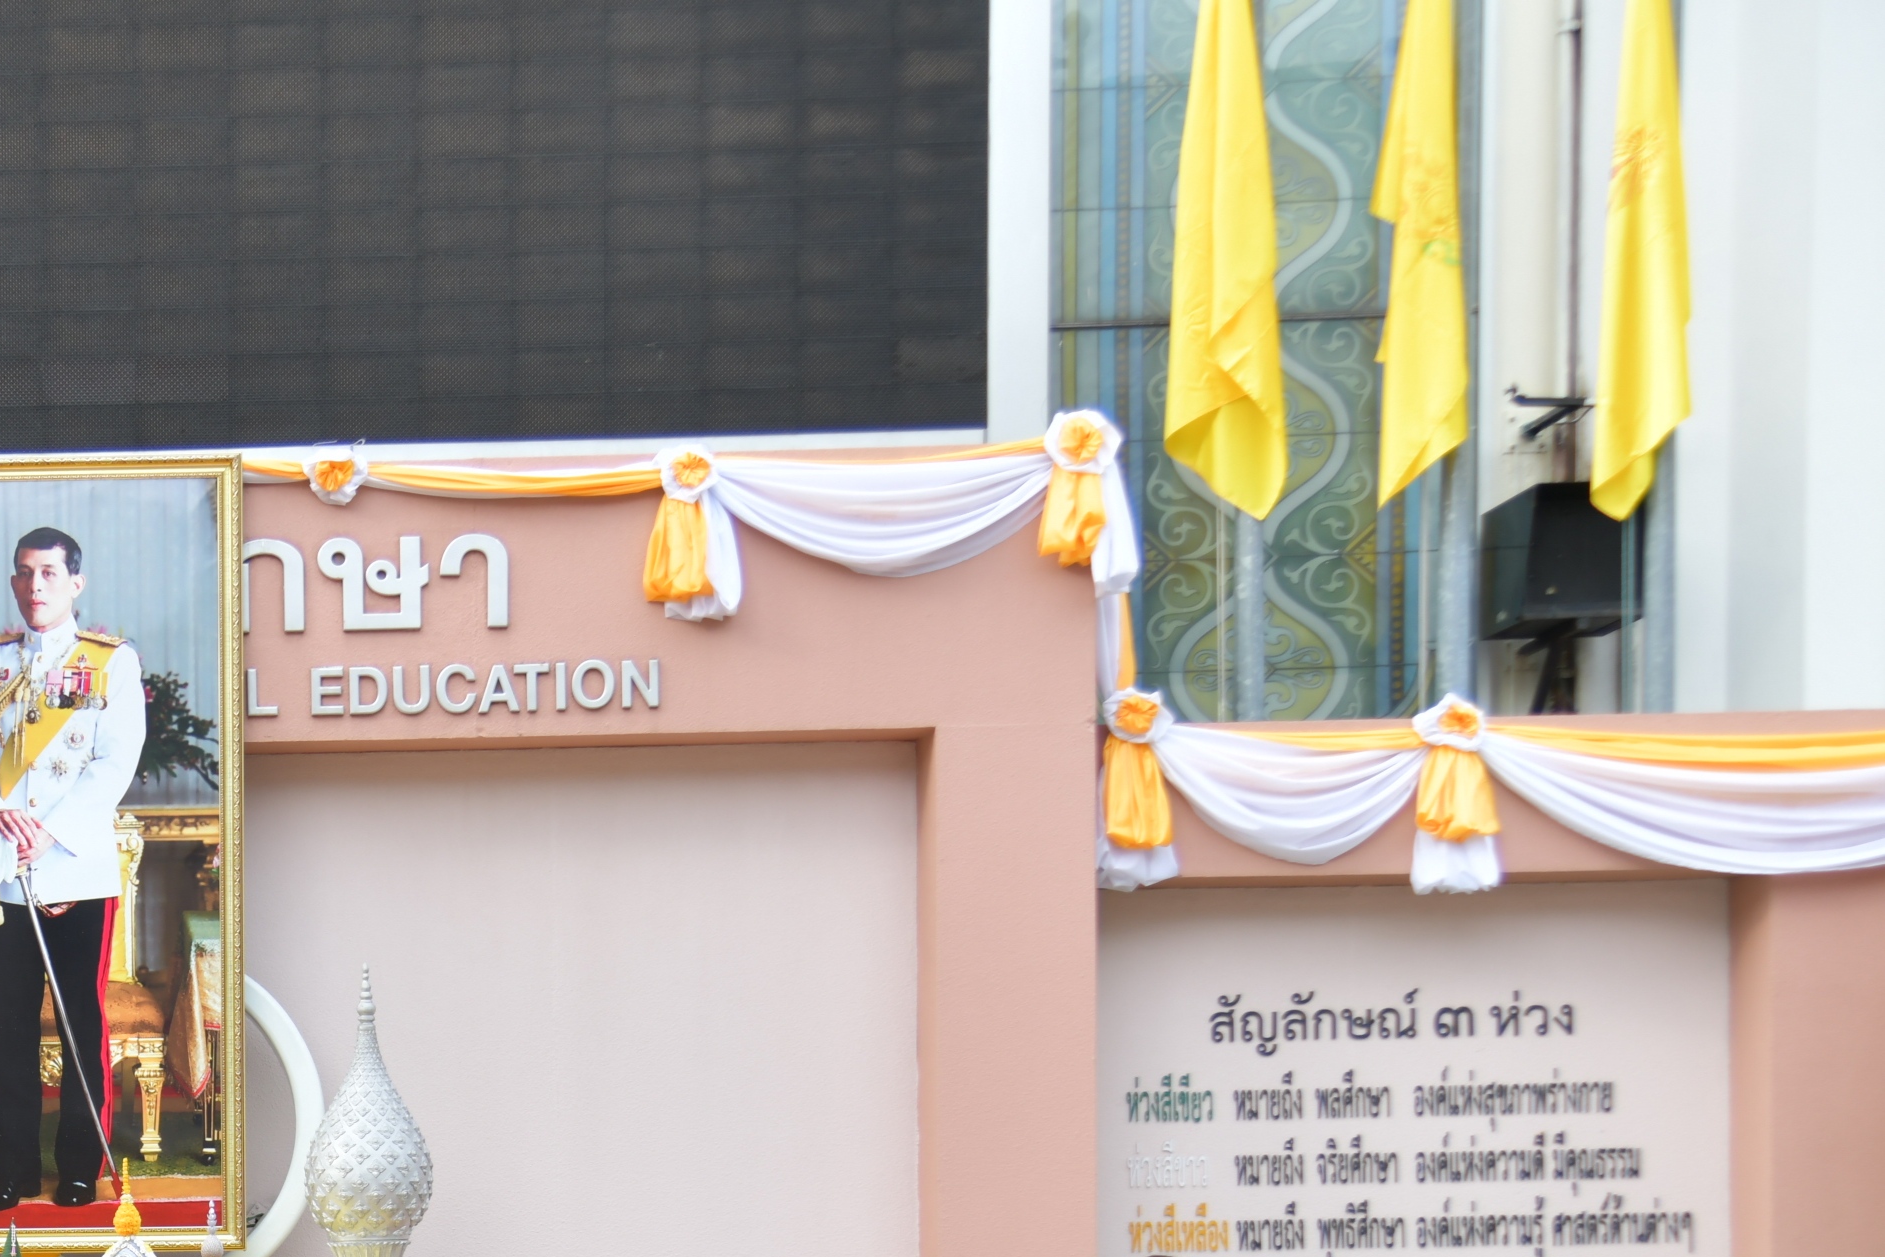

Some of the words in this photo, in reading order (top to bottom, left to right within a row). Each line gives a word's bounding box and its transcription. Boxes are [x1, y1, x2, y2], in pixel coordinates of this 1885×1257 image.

[310, 658, 661, 717] EDUCATION
[1208, 988, 1420, 1056] สัญลักษณ์
[1433, 1003, 1476, 1038] ๓
[1488, 990, 1576, 1036] ห่วง
[1125, 1072, 1214, 1123] ห่วงสีเขียว
[1232, 1070, 1304, 1121] หมายถึง
[1315, 1068, 1393, 1119] พลศึกษา
[1413, 1065, 1615, 1132] องค์แห่งสุขภาพร่างกาย
[1234, 1137, 1305, 1186] หมายถึง
[1316, 1134, 1400, 1185] จริยศึกษา
[1415, 1131, 1546, 1183] องค์แห่งความดี
[1552, 1131, 1642, 1197] มีคุณธรรม
[1128, 1202, 1230, 1253] ห่วงสีเหลือง
[1235, 1200, 1306, 1251] หมายถึง
